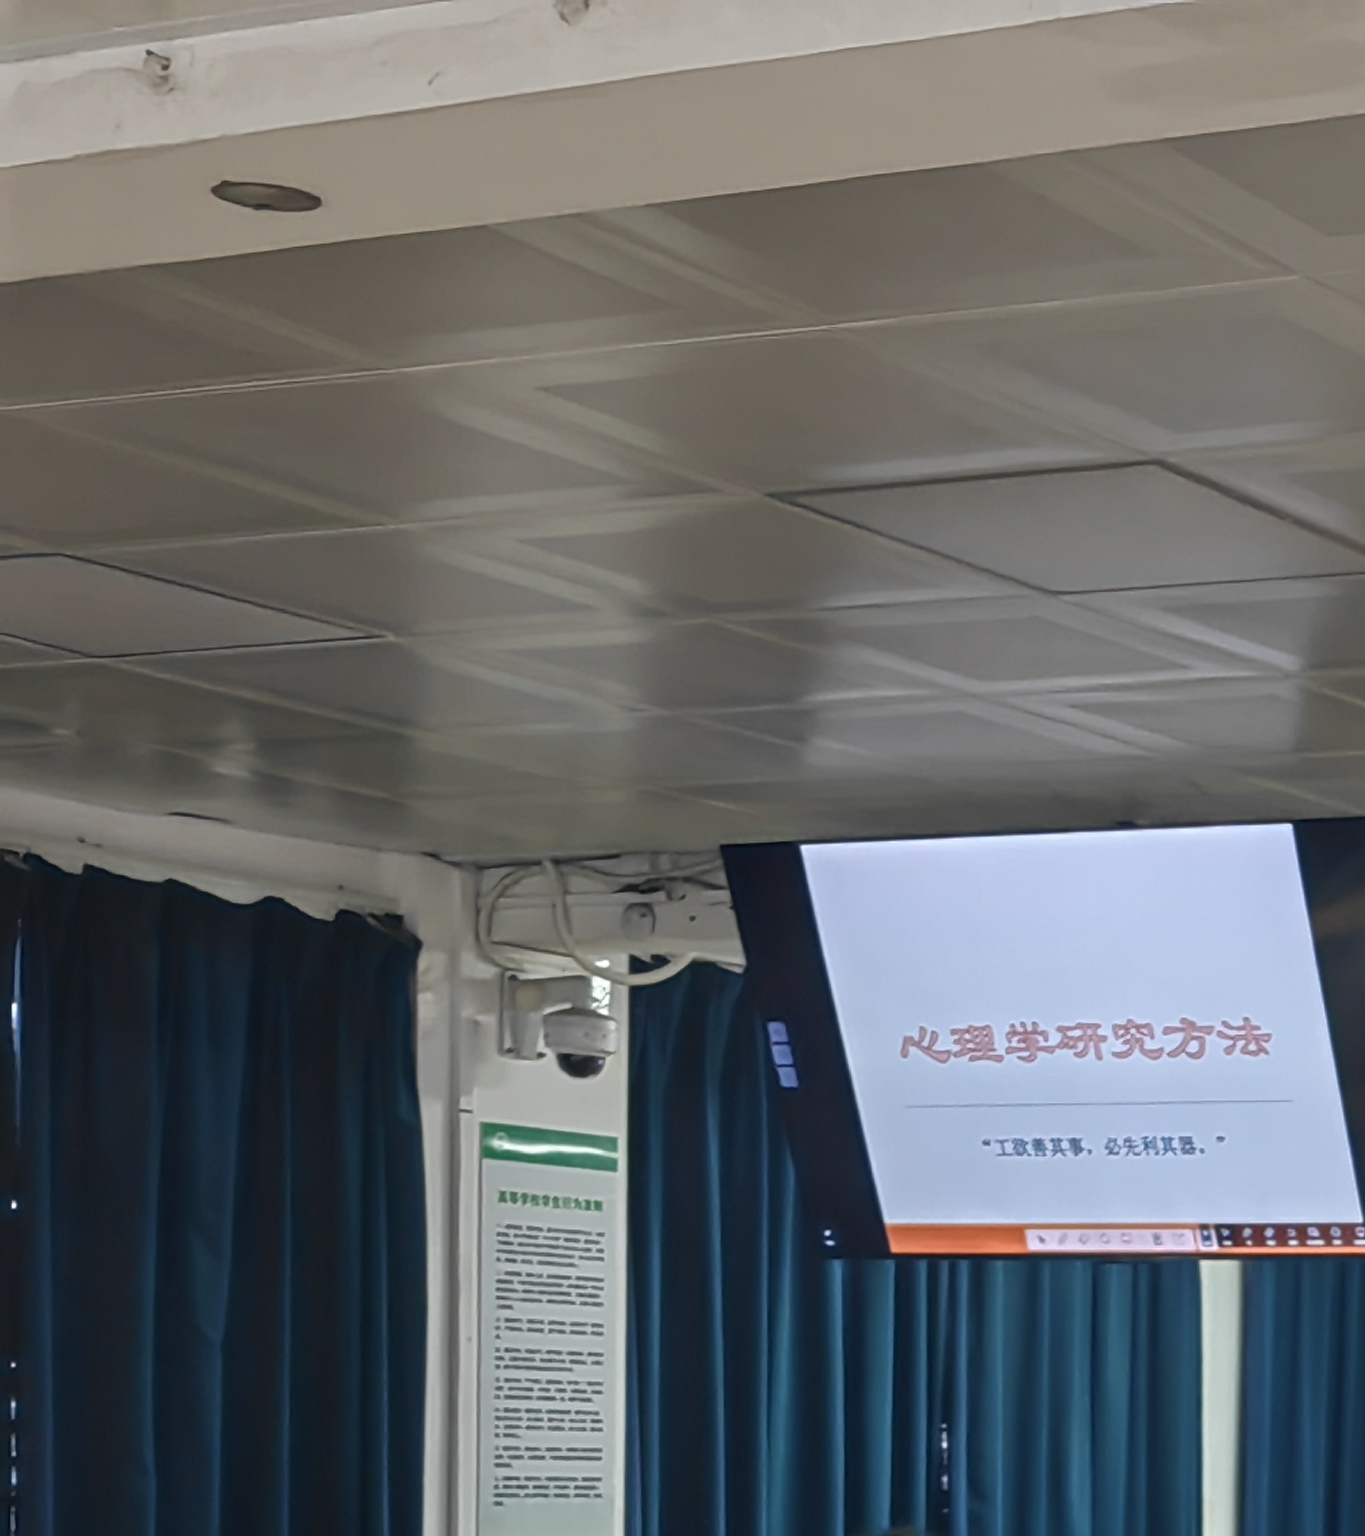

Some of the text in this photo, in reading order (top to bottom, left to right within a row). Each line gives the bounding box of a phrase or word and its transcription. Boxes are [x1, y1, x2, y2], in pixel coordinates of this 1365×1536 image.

[899, 1015, 1274, 1065] 心理学研究方法
